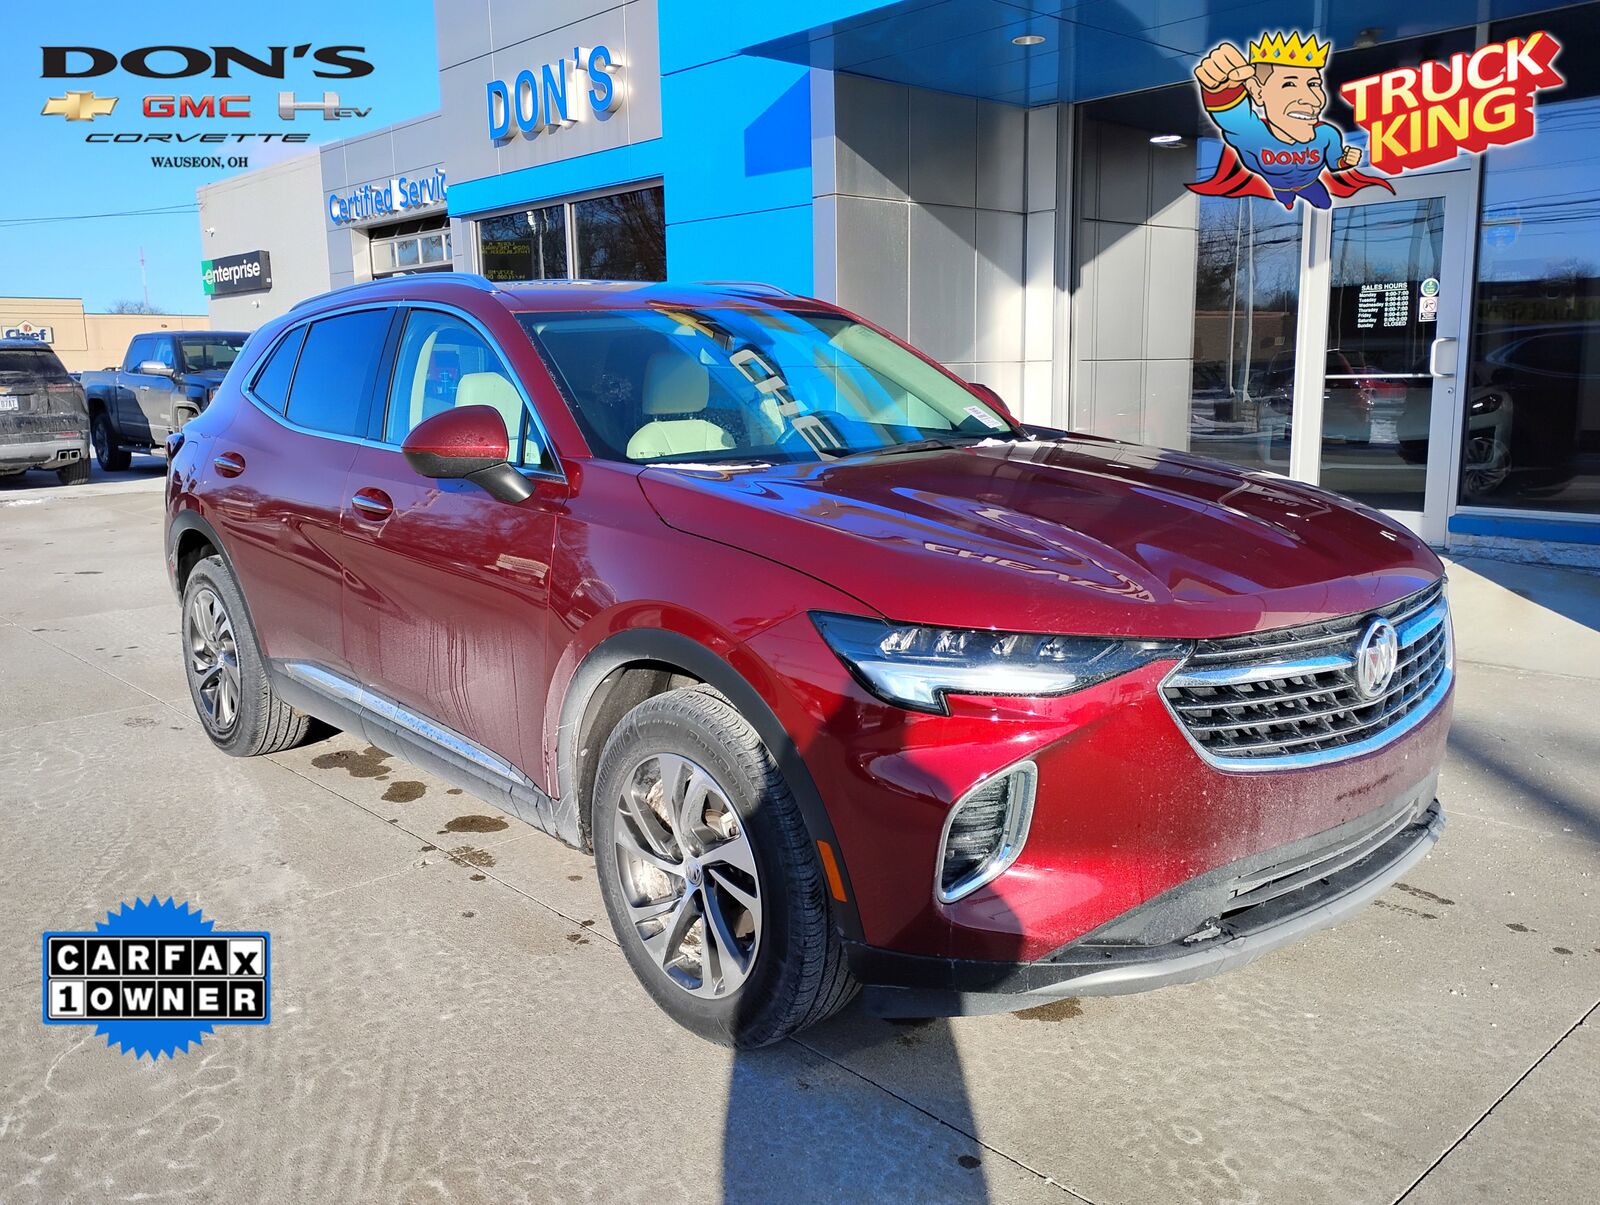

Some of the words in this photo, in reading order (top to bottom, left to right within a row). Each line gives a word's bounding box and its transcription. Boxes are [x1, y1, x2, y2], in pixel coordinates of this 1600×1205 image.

[486, 45, 617, 141] DON'S
[329, 180, 394, 224] Certified
[399, 167, 447, 208] Servic
[205, 259, 260, 285] enterprise
